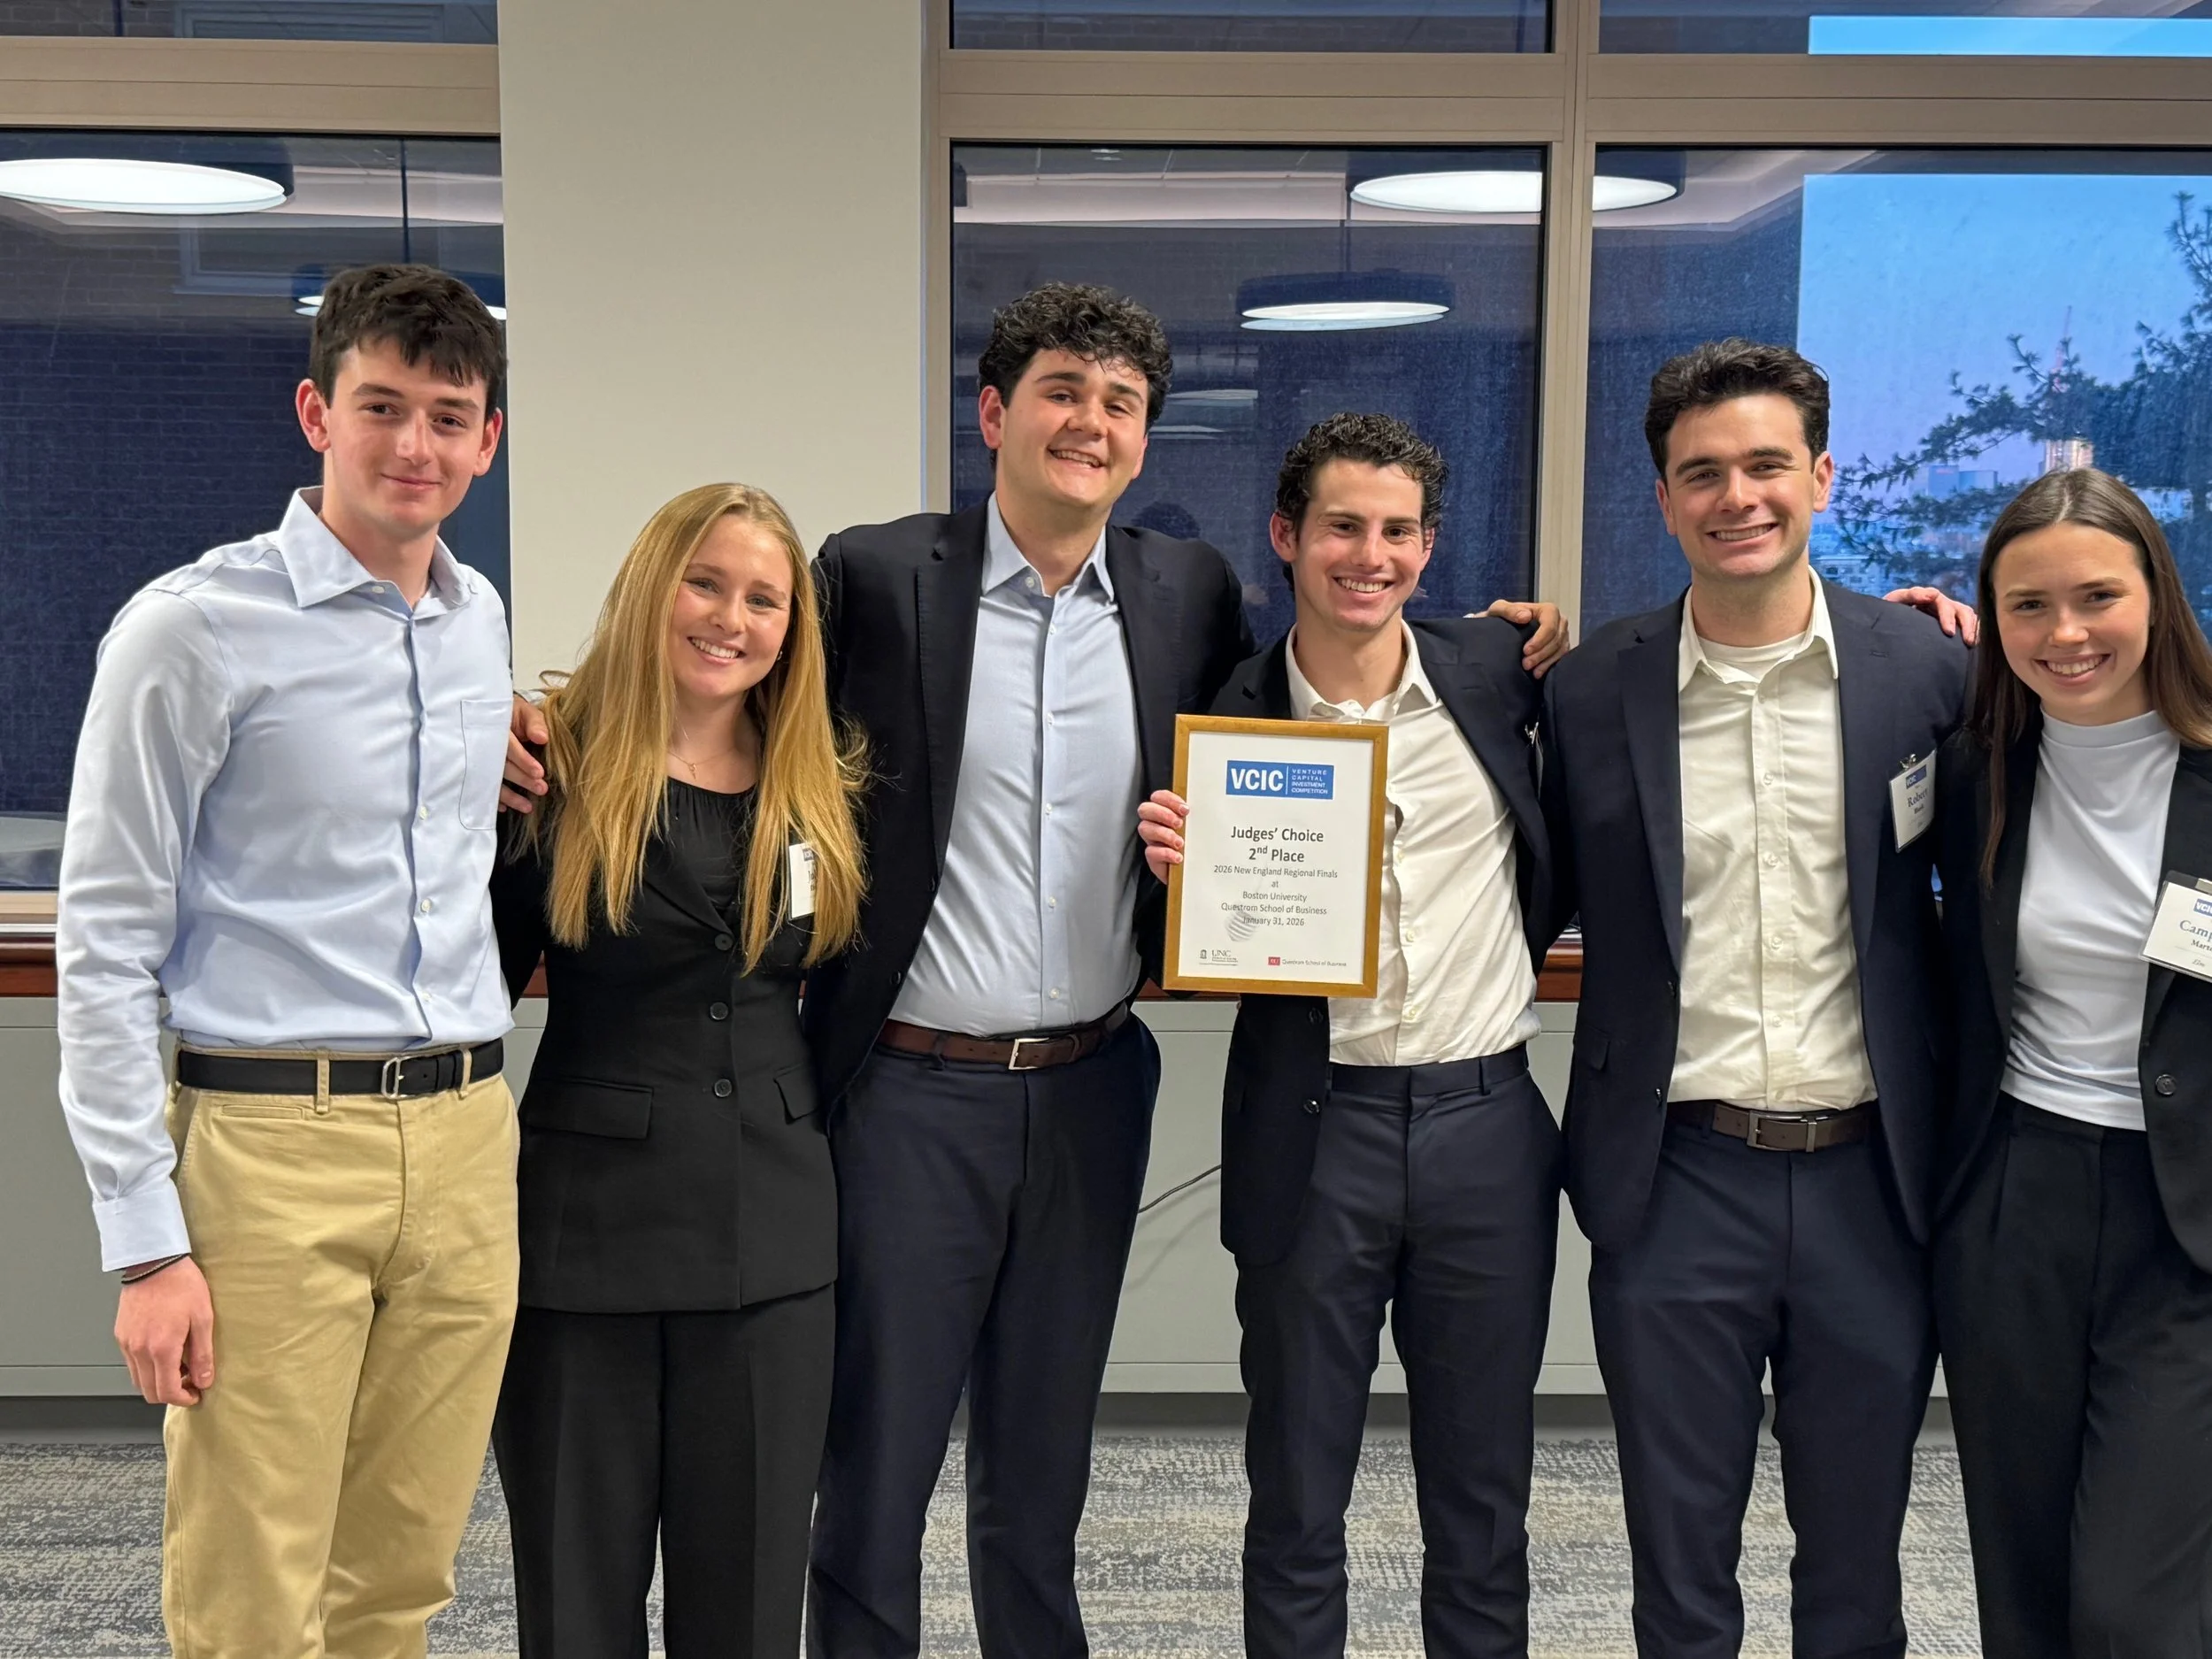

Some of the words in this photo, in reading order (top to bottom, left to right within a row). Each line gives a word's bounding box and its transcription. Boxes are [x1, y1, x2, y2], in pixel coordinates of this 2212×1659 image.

[1231, 768, 1284, 792] VCIC
[1908, 788, 1927, 807] Robert
[1281, 828, 1324, 841] Choice
[1271, 849, 1305, 862] Place
[1213, 864, 1233, 873] 2026
[1252, 867, 1282, 877] England
[1284, 868, 1316, 878] Regional
[1242, 891, 1268, 900] Boston
[1270, 892, 1308, 902] University
[1221, 902, 1258, 912] Questrom
[1295, 905, 1327, 915] Business
[1242, 916, 1271, 926] January
[1272, 917, 1284, 926] 31,
[1286, 918, 1305, 926] 2026
